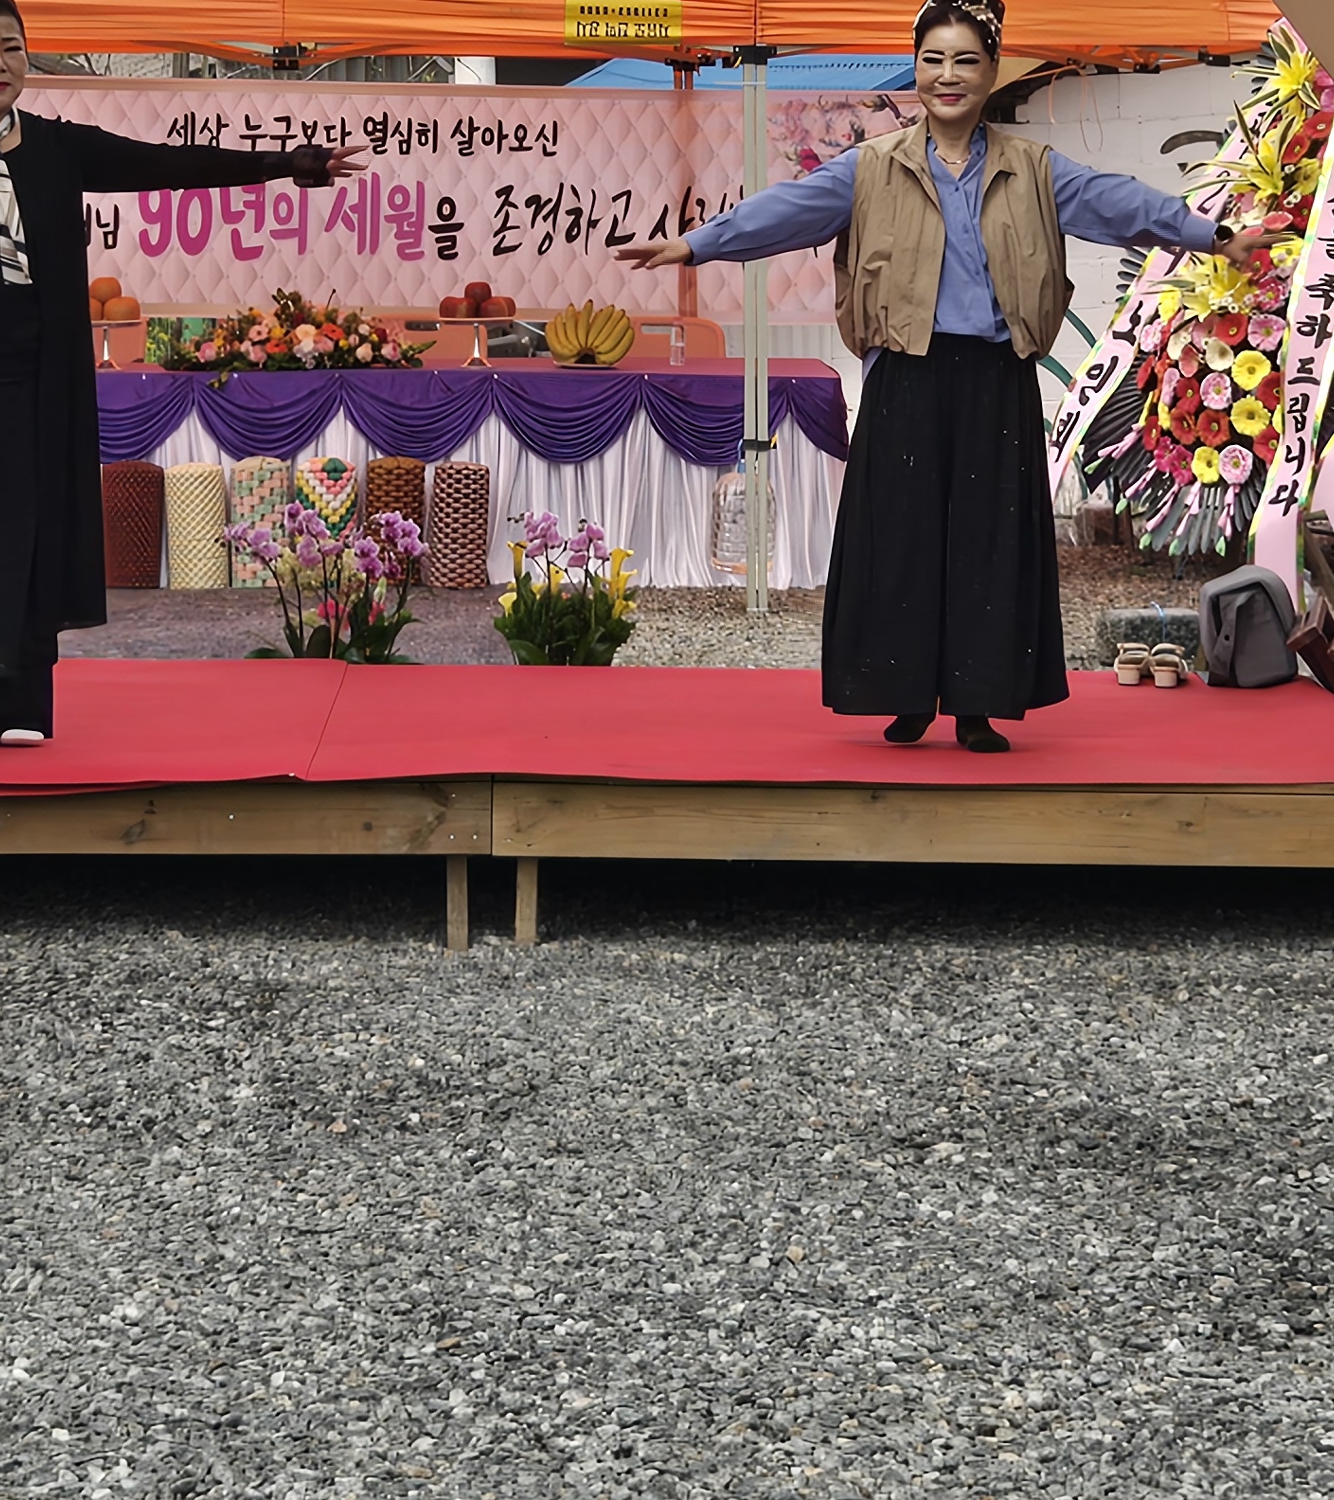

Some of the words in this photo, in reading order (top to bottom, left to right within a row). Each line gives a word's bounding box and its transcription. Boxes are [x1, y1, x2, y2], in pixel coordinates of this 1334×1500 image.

[167, 111, 229, 148] 세상
[239, 115, 352, 151] 누구보다
[363, 111, 439, 156] 열심히
[450, 115, 558, 157] 살아오신
[84, 202, 119, 251] 님
[138, 181, 309, 262] 90년의
[324, 171, 465, 261] 세월을
[492, 182, 636, 257] 존경하고
